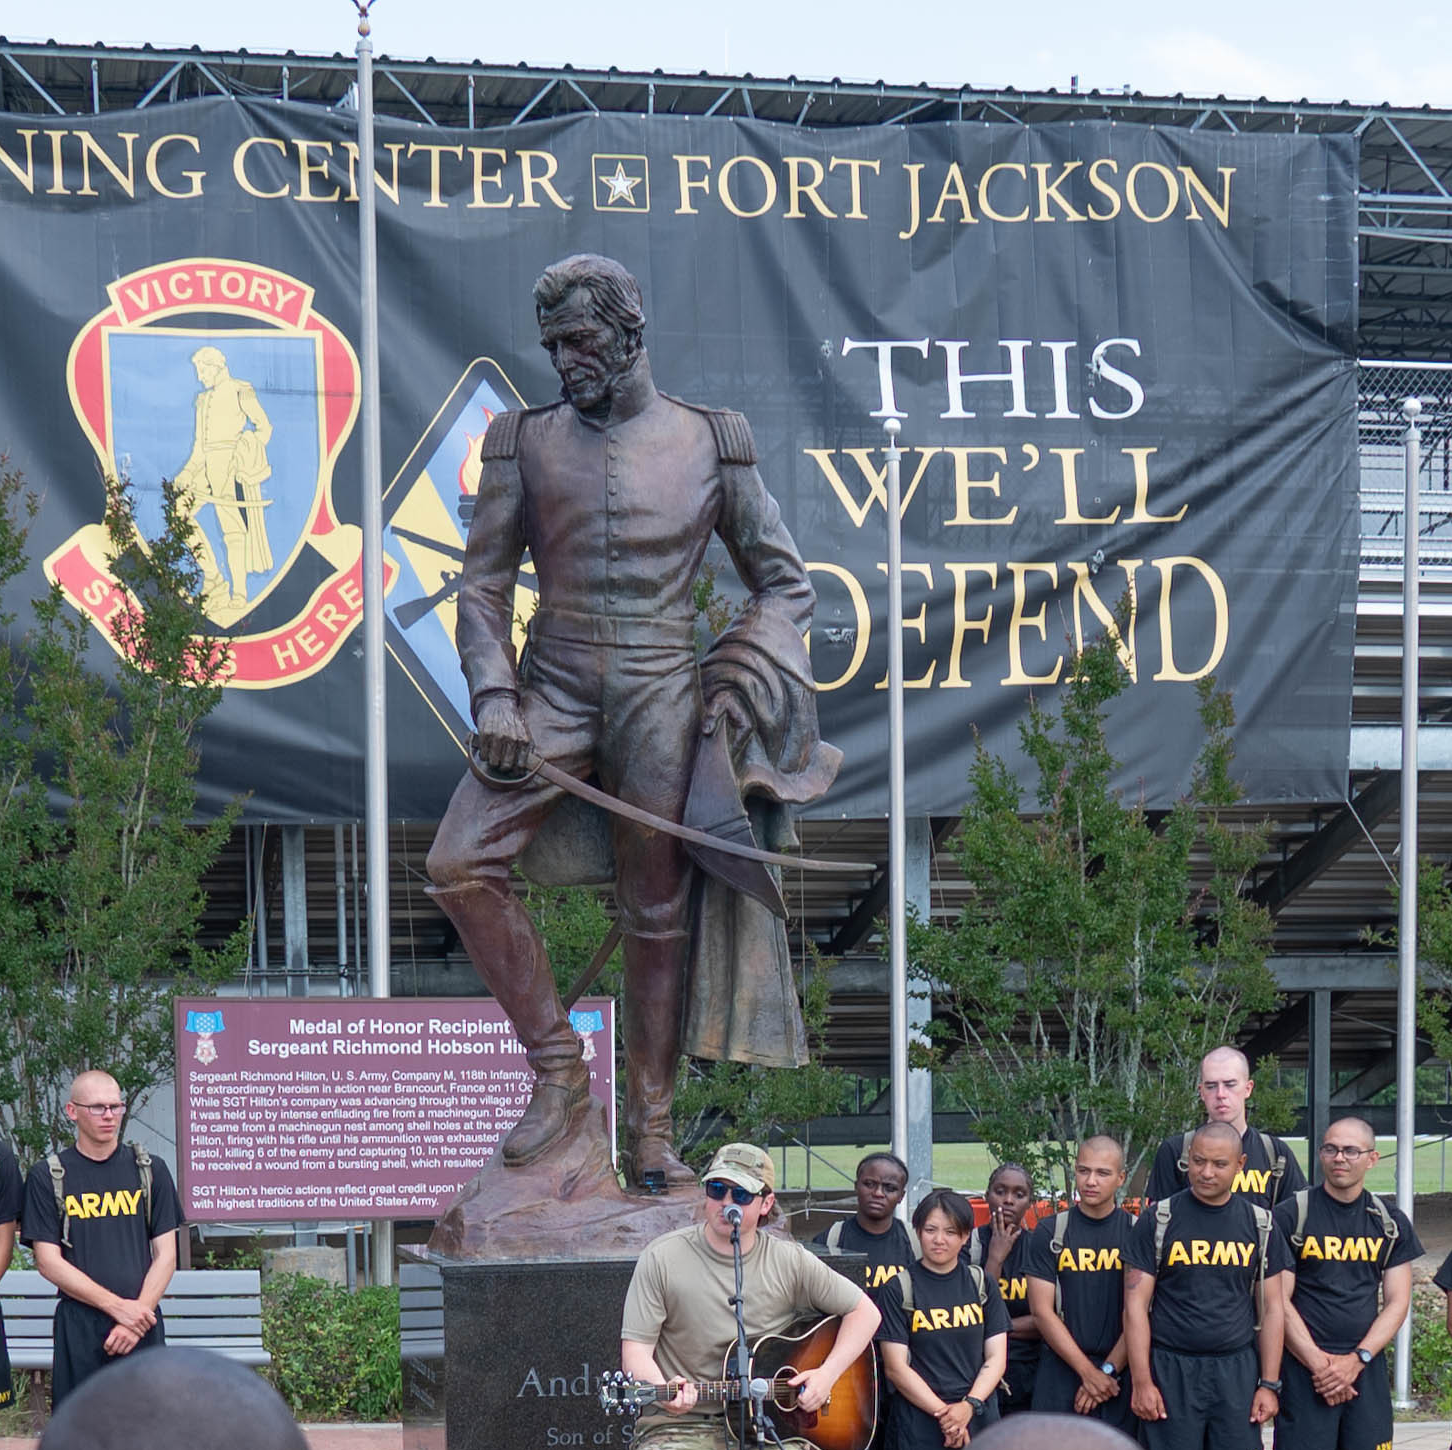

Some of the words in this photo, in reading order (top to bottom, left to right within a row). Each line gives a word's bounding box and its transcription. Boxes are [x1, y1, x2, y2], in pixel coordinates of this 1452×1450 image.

[232, 135, 572, 211] CENTER
[672, 154, 880, 221] FORT
[899, 158, 1237, 240] JACKSON
[125, 267, 297, 315] VICTORY
[841, 337, 1145, 419] THIS
[804, 442, 1189, 529] WE'LL
[271, 579, 364, 671] HERE
[289, 1019, 341, 1034] Medal
[347, 1018, 365, 1034] of
[369, 1018, 424, 1034] Honor
[428, 1018, 510, 1036] Recipient
[248, 1039, 328, 1058] Sergeant
[333, 1039, 421, 1054] Richmond
[427, 1039, 494, 1054] Hobson
[189, 1071, 237, 1084] Sergeant
[240, 1070, 293, 1081] Richmond
[359, 1070, 388, 1083] Army,
[391, 1070, 441, 1083] Company
[460, 1069, 487, 1080] 118th
[189, 1083, 204, 1094] for
[206, 1083, 275, 1096] extraordinary
[277, 1083, 319, 1093] heroism
[334, 1083, 365, 1093] action
[367, 1084, 391, 1093] near
[449, 1082, 485, 1092] France
[487, 1084, 501, 1092] on
[504, 1082, 514, 1092] 11
[189, 1096, 219, 1107] While
[222, 1096, 247, 1107] SGT
[249, 1096, 288, 1106] Hilton's
[290, 1098, 338, 1109] company
[340, 1097, 361, 1106] was
[364, 1095, 416, 1108] advancing
[418, 1095, 458, 1108] through
[460, 1095, 477, 1105] the
[479, 1095, 511, 1108] village
[514, 1094, 524, 1105] of
[190, 1109, 196, 1120] it
[199, 1111, 221, 1120] was
[223, 1109, 246, 1120] held
[248, 1111, 262, 1122] up
[264, 1109, 277, 1122] by
[280, 1109, 318, 1119] intense
[320, 1108, 370, 1121] enfilading
[372, 1108, 389, 1119] fire
[392, 1108, 415, 1119] from
[495, 1107, 525, 1118] Disco
[190, 1122, 207, 1132] fire
[210, 1123, 239, 1132] came
[241, 1121, 265, 1132] from
[277, 1121, 341, 1134] machinegun
[344, 1121, 366, 1131] nest
[368, 1122, 404, 1133] among
[406, 1120, 430, 1131] shell
[433, 1120, 461, 1130] holes
[463, 1120, 473, 1130] at
[476, 1120, 492, 1130] the
[227, 1134, 253, 1147] firing
[255, 1134, 276, 1144] with
[279, 1134, 295, 1144] his
[297, 1134, 316, 1144] rifle
[319, 1133, 341, 1144] until
[343, 1133, 359, 1144] his
[361, 1133, 420, 1143] ammunition
[423, 1135, 444, 1143] was
[446, 1132, 499, 1143] exhausted
[190, 1147, 221, 1160] pistol,
[224, 1147, 254, 1160] killing
[266, 1147, 277, 1157] of
[279, 1147, 296, 1157] the
[298, 1148, 334, 1159] enemy
[336, 1146, 356, 1157] and
[358, 1146, 406, 1159] capturing
[440, 1145, 457, 1156] the
[459, 1147, 493, 1156] course
[191, 1160, 205, 1170] he
[207, 1160, 252, 1170] received
[264, 1159, 299, 1170] wound
[302, 1159, 325, 1169] from
[337, 1159, 379, 1171] bursting
[381, 1158, 408, 1170] shell,
[410, 1158, 440, 1168] which
[443, 1158, 483, 1168] resulted
[192, 1185, 216, 1196] SGT
[219, 1185, 258, 1195] Hilton's
[260, 1184, 292, 1195] heroic
[294, 1184, 332, 1195] actions
[334, 1184, 366, 1194] reflect
[368, 1184, 395, 1196] great
[397, 1183, 426, 1194] credit
[428, 1185, 454, 1196] upon
[64, 1190, 142, 1220] ARMY
[192, 1198, 213, 1208] with
[216, 1198, 254, 1211] highest
[257, 1197, 304, 1208] traditions
[306, 1197, 317, 1207] of
[320, 1197, 336, 1207] the
[339, 1197, 372, 1207] United
[375, 1196, 408, 1207] States
[410, 1196, 438, 1209] Army.
[1167, 1242, 1253, 1267] ARMY
[1300, 1236, 1381, 1262] ARMY
[911, 1309, 984, 1333] ARMY
[516, 1363, 600, 1398] And
[546, 1427, 584, 1447] Son
[592, 1424, 614, 1445] of
